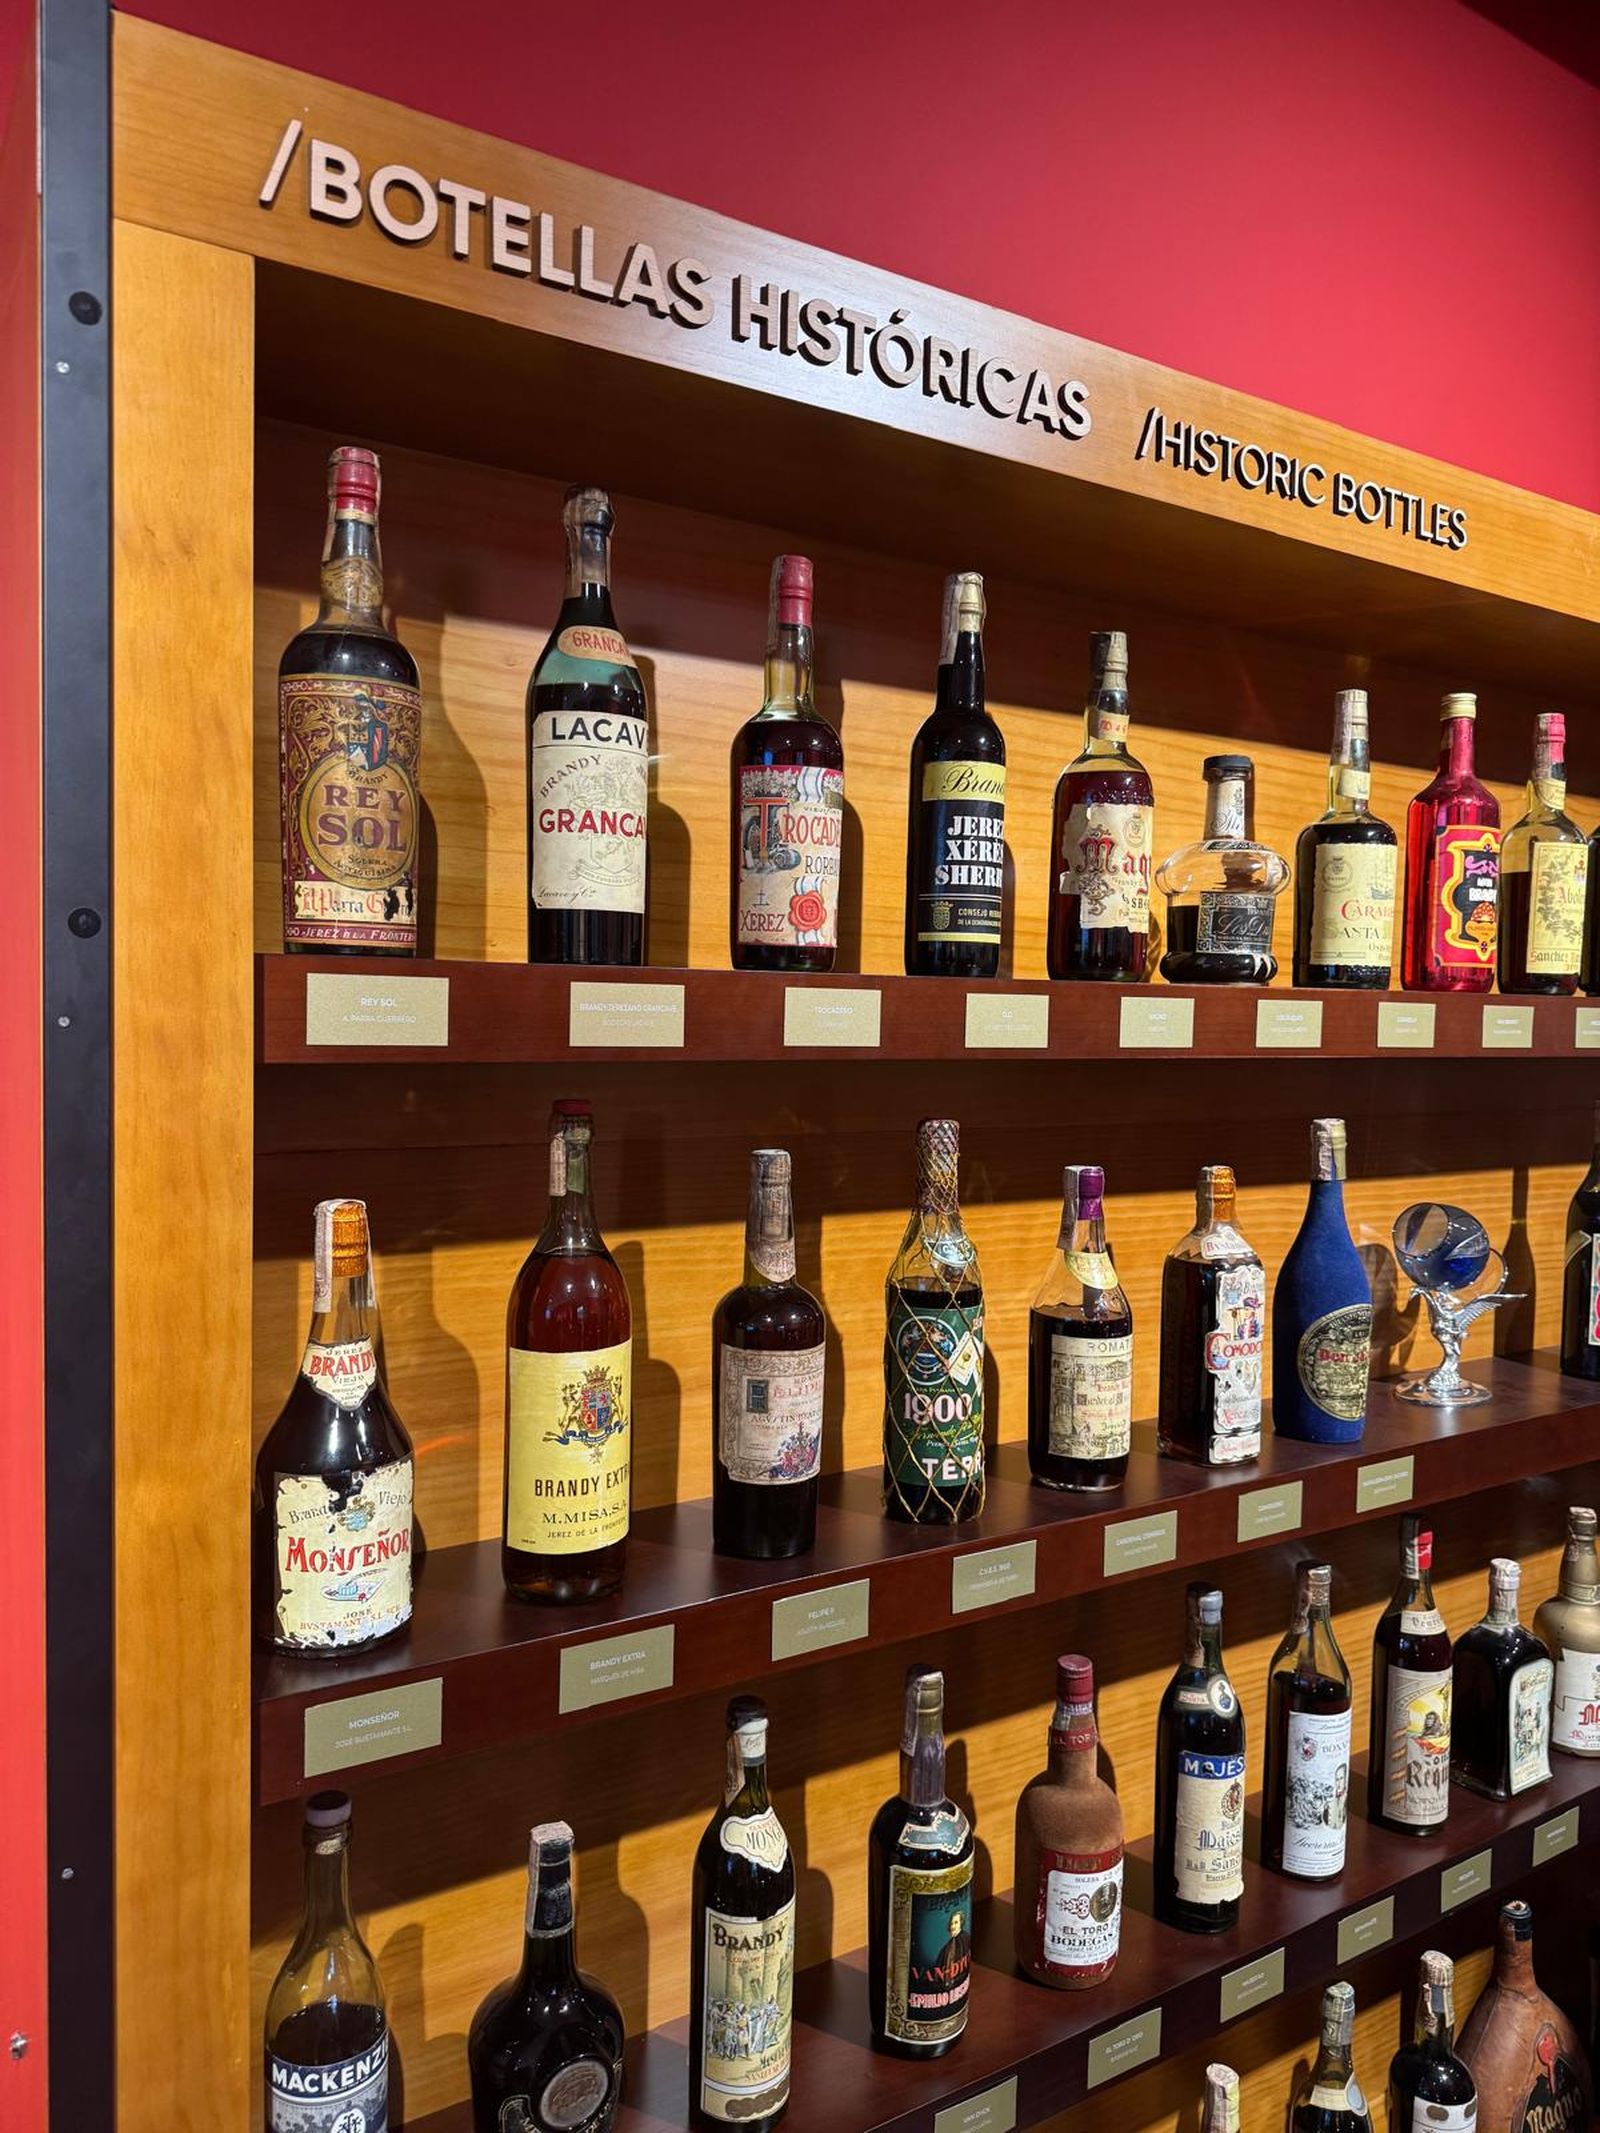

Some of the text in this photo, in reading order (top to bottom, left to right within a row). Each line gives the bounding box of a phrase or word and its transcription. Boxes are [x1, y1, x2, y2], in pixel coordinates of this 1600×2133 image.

[731, 274, 1093, 440] HISTÓRICAS
[1332, 472, 1468, 551] BOTTLES
[540, 754, 603, 799] BRANDY
[323, 784, 406, 812] REY
[317, 813, 407, 852] SOL
[539, 809, 646, 839] GRANCA
[740, 909, 785, 933] XEREZ
[903, 1392, 973, 1425] 1900
[535, 1475, 600, 1498] BRANDY
[288, 1503, 330, 1524] Brand
[1184, 1756, 1245, 1777] MJES
[712, 1922, 787, 1952] BRANDY
[1062, 1922, 1109, 1936] EL TORO
[271, 2038, 387, 2094] MACKENZI
